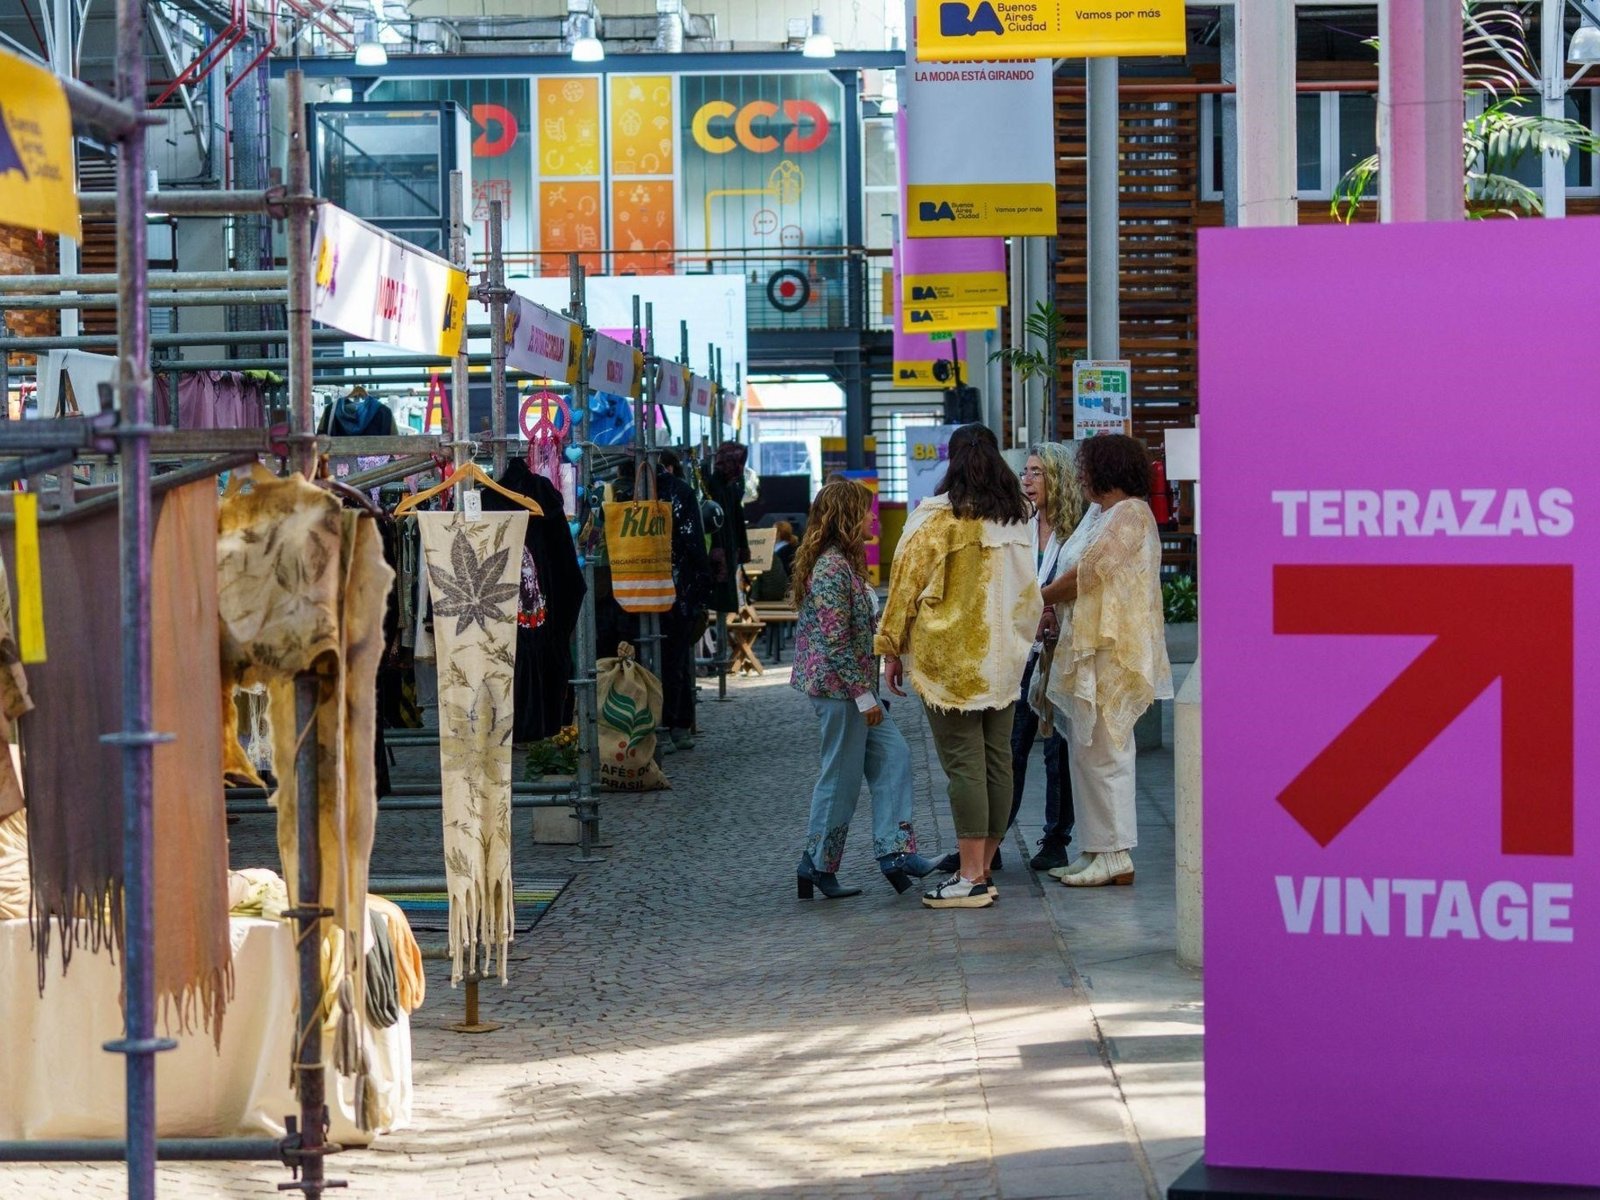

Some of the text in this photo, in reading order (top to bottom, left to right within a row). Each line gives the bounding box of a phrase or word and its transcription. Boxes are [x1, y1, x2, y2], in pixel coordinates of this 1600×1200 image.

[997, 3, 1038, 12] Buenos
[1075, 8, 1161, 21] Vamos por más
[940, 1, 1004, 36] BA
[1004, 13, 1034, 21] Aires
[1008, 22, 1047, 32] Ciudad
[915, 69, 1034, 82] LA MODA ESTÁ GIRANDO
[692, 99, 830, 154] CCD
[919, 201, 956, 221] BA
[912, 285, 938, 301] BA
[911, 310, 933, 322] BA
[1272, 487, 1574, 537] TERRAZAS
[1275, 875, 1574, 943] VINTAGE
